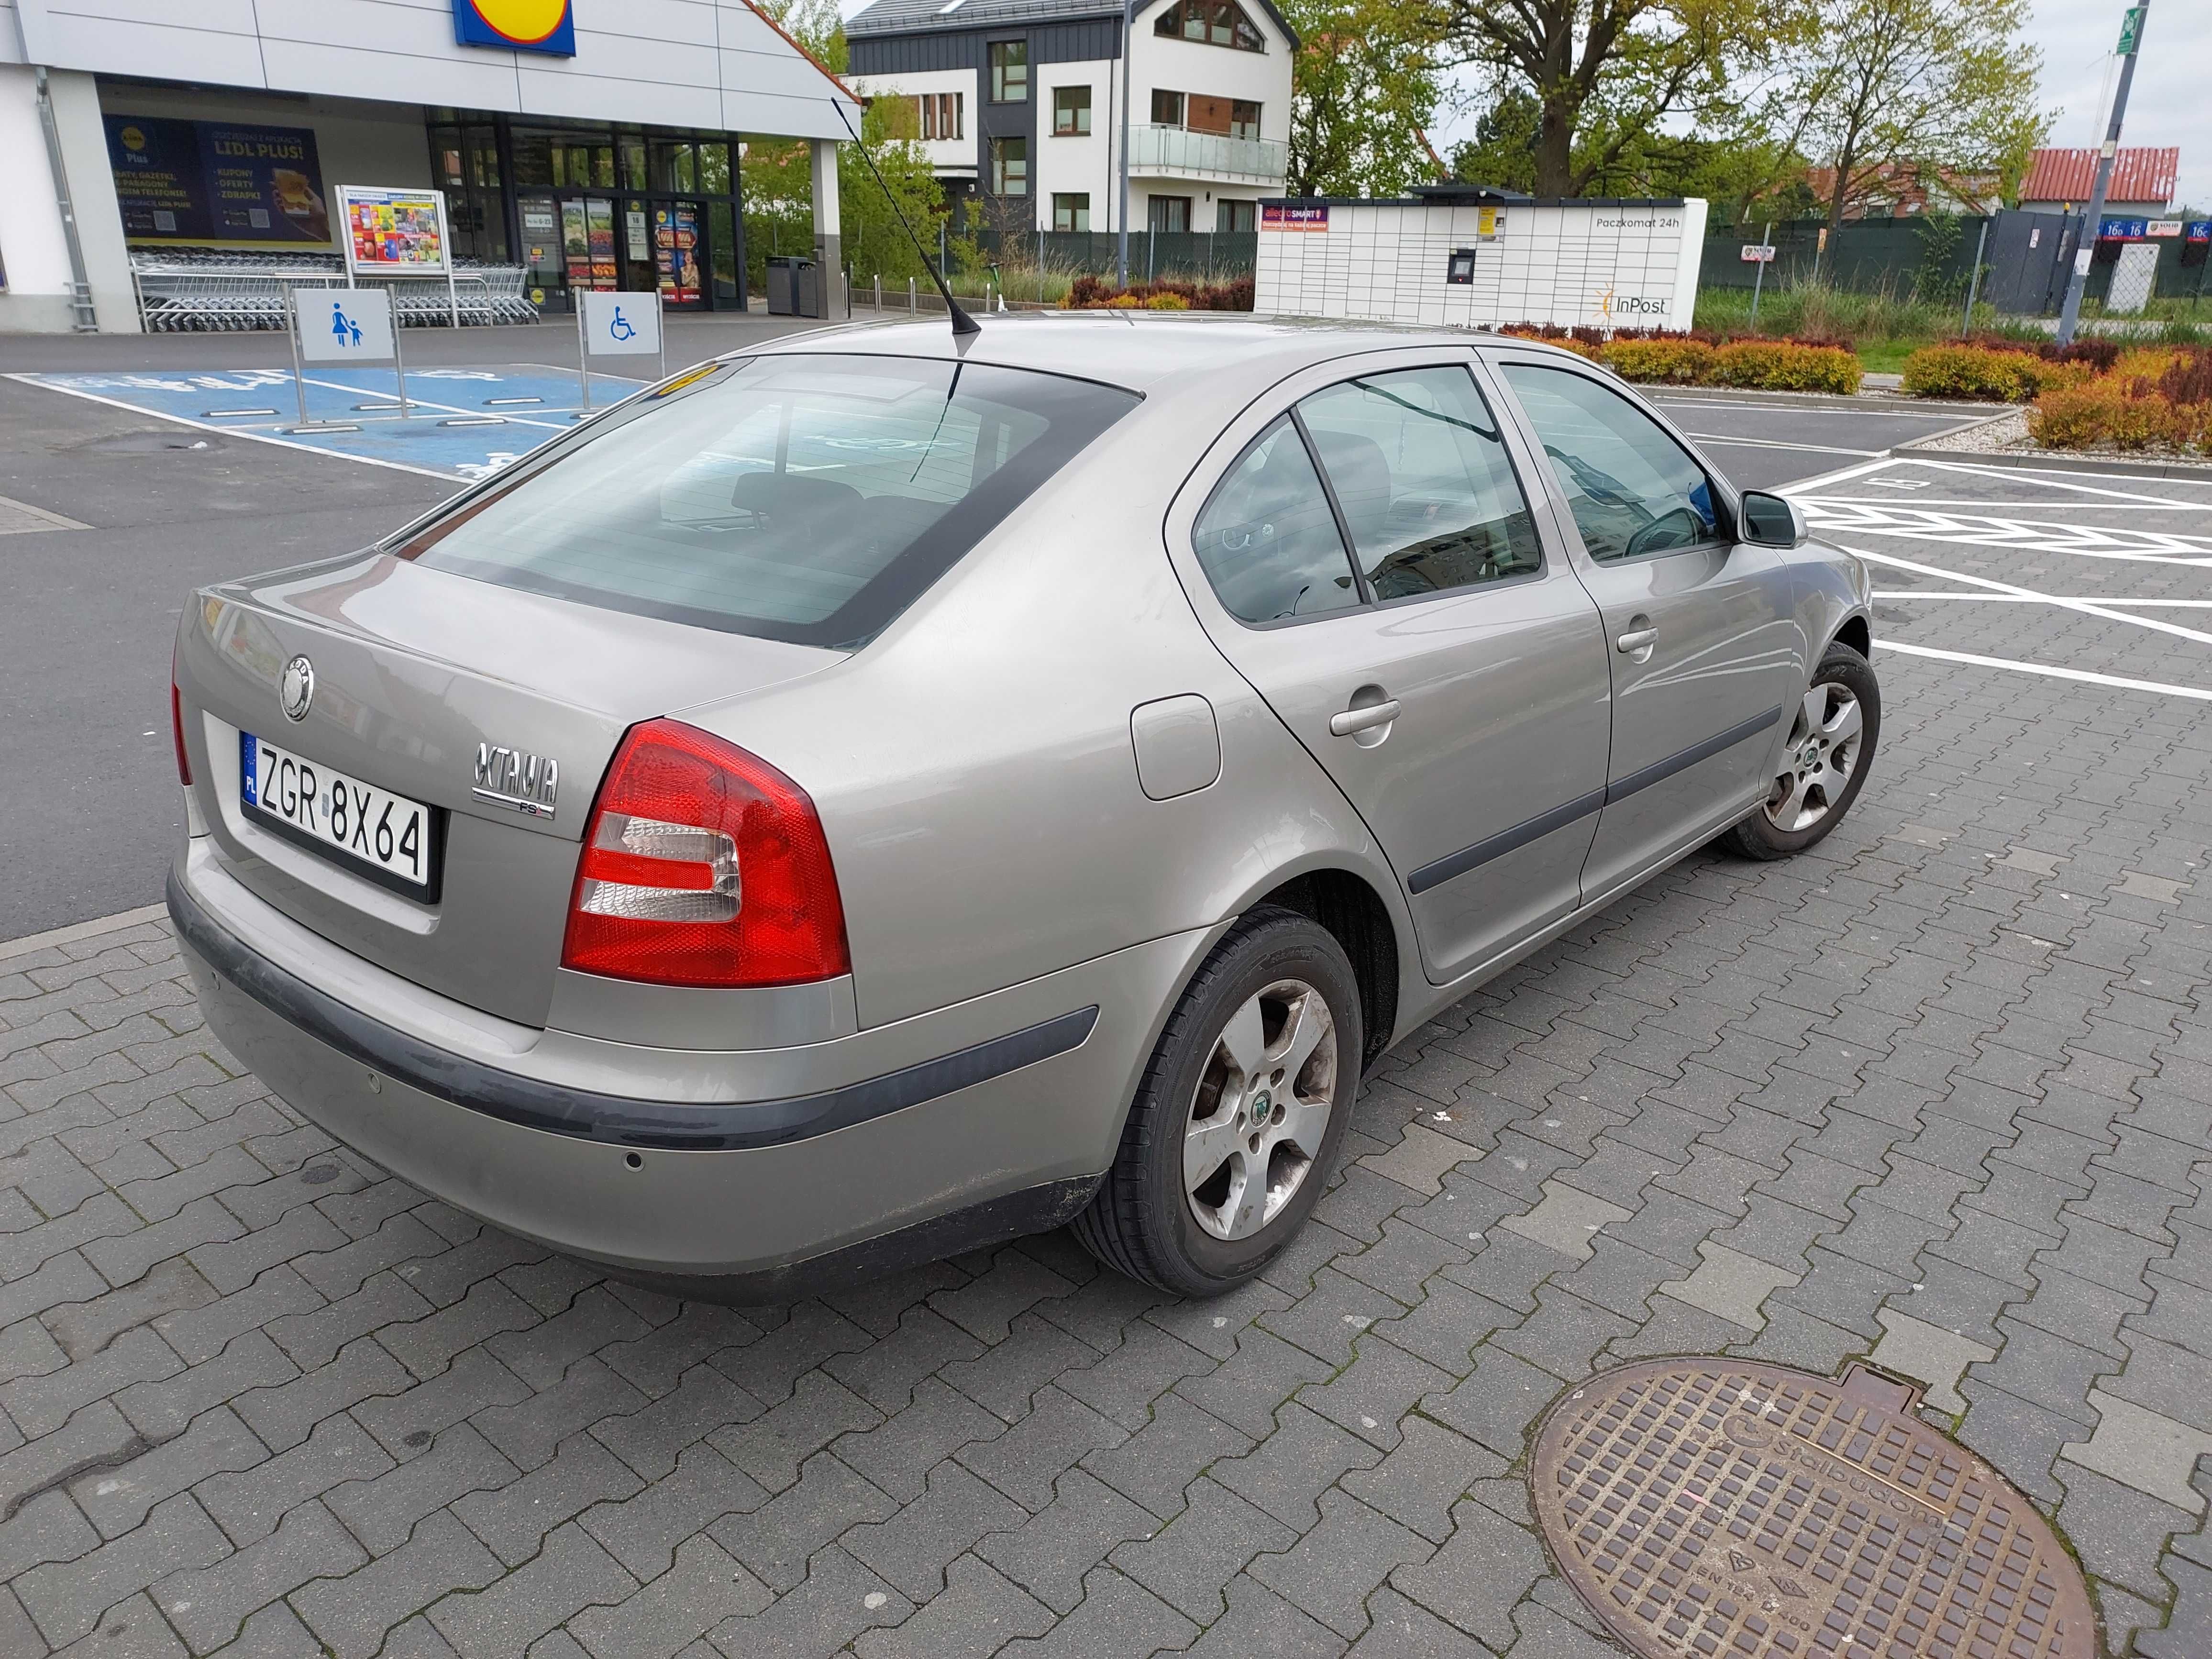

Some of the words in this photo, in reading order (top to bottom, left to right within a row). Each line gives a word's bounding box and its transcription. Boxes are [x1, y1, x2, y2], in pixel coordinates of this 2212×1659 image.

[126, 153, 148, 163] Plus
[214, 141, 254, 156] LIDL
[256, 144, 304, 160] PLUS!
[1596, 218, 1656, 228] Paczkomat
[1659, 218, 1679, 228] 24h
[2130, 225, 2141, 236] 16
[1616, 297, 1665, 314] InPost
[288, 660, 309, 685] KODA
[475, 742, 558, 803] OCTAVIA
[246, 775, 256, 794] PL
[262, 747, 317, 830] ZGR
[332, 780, 419, 876] 8X64
[1773, 1438, 1944, 1528] Stalbudom
[1697, 1566, 1722, 1584] EN
[1778, 1611, 1811, 1631] 400
